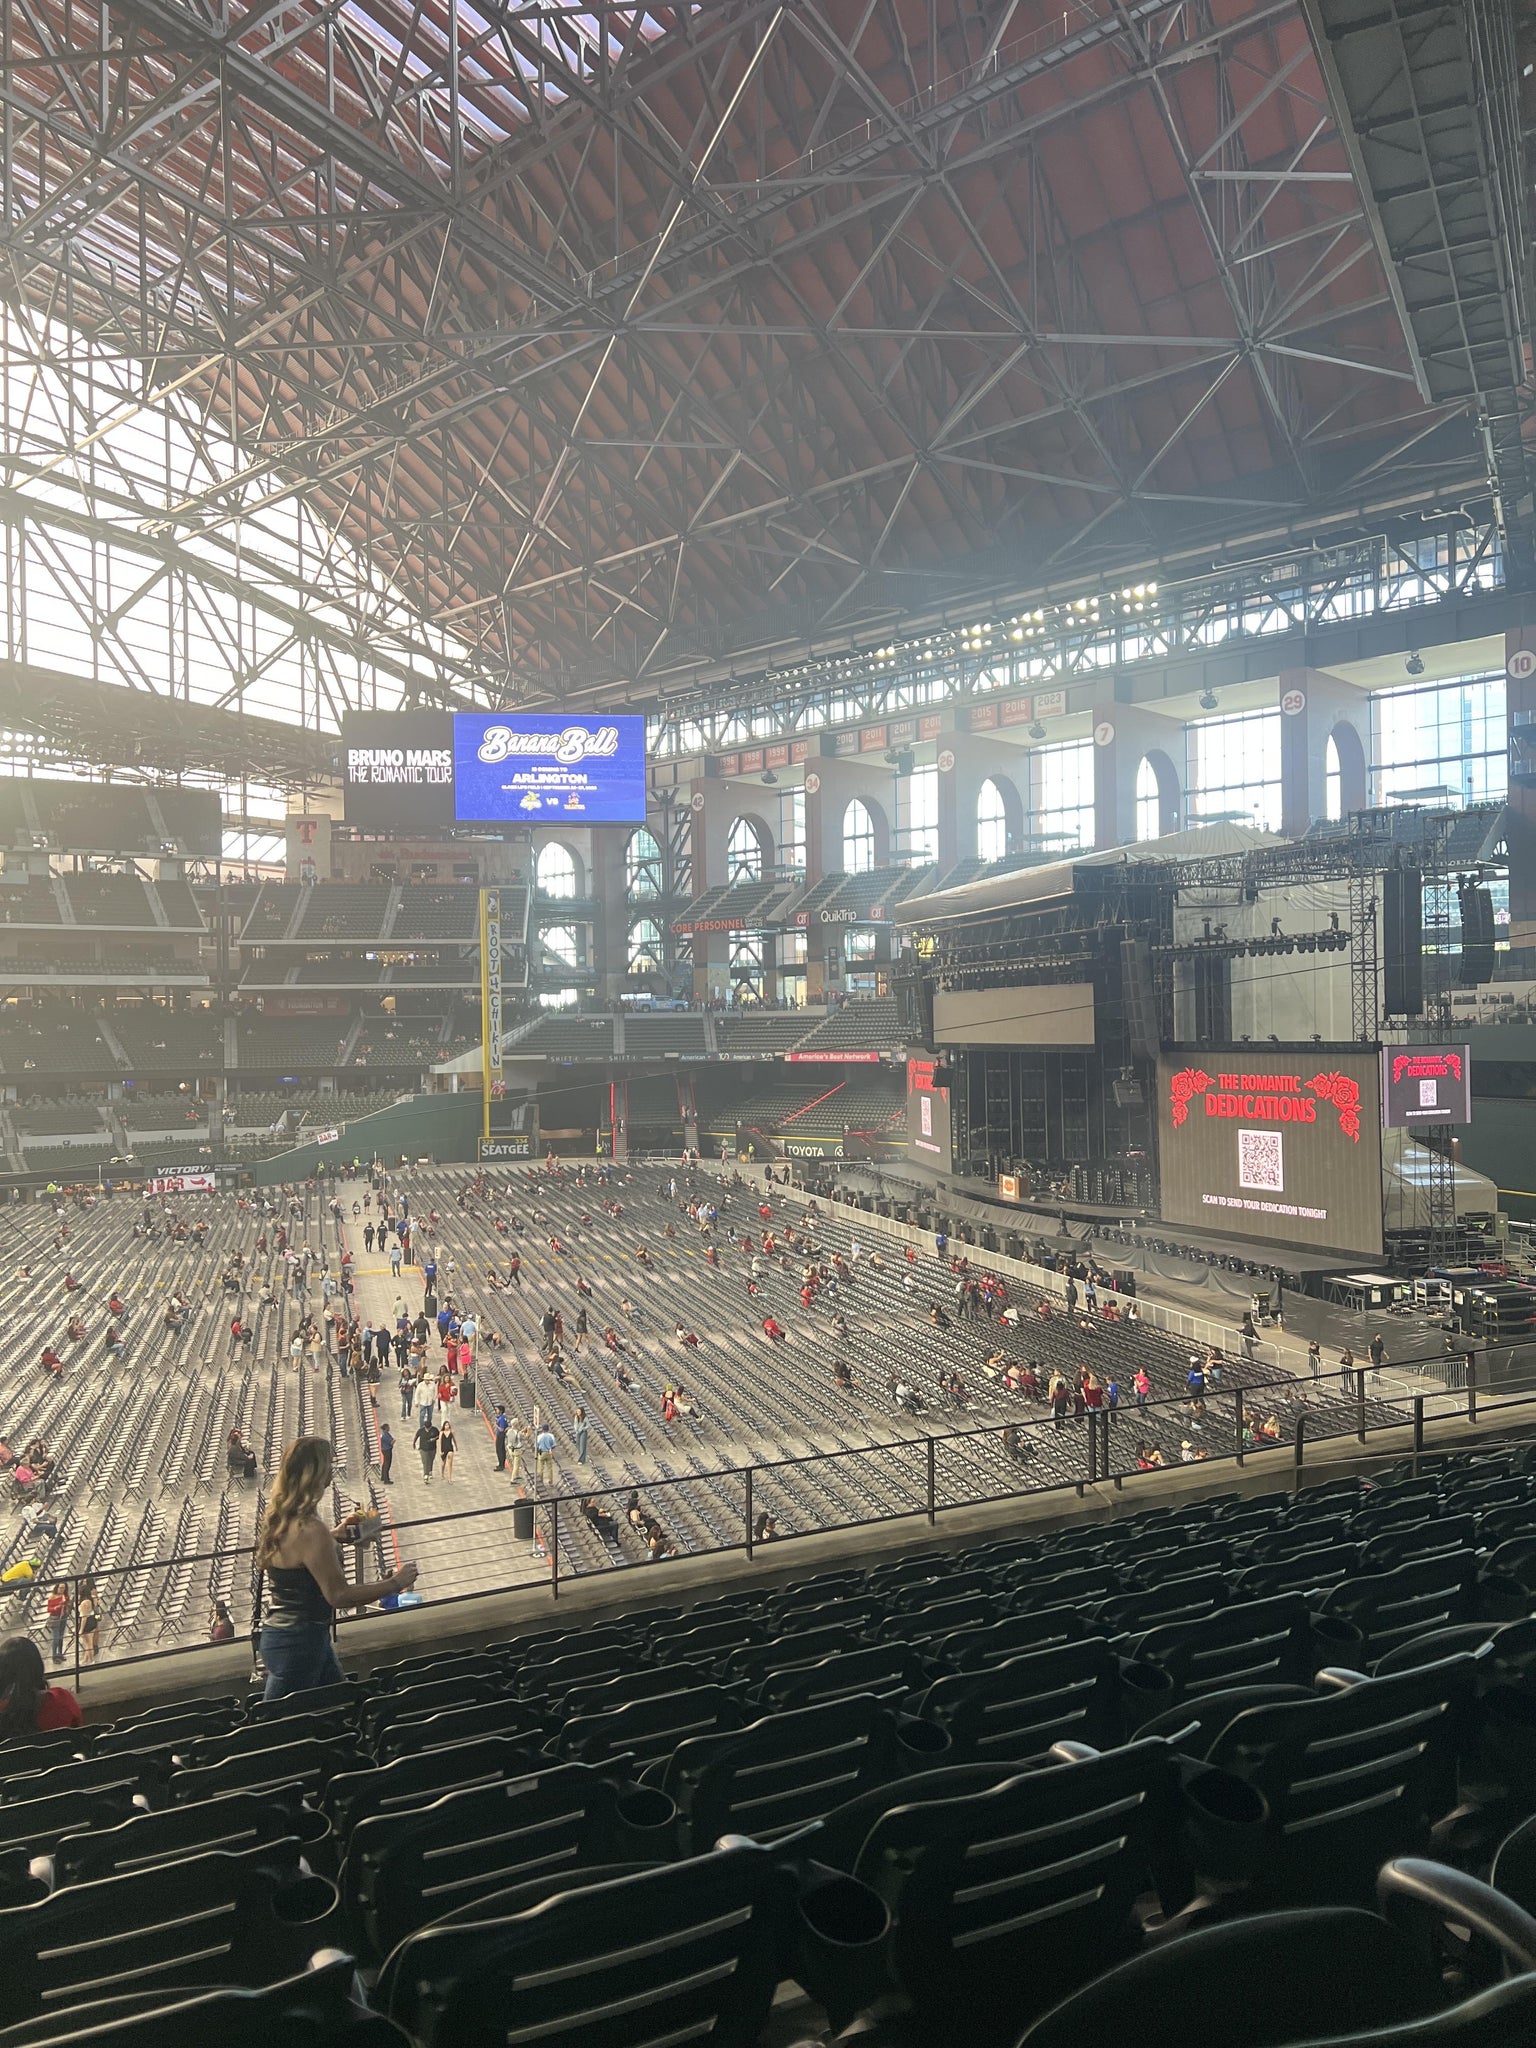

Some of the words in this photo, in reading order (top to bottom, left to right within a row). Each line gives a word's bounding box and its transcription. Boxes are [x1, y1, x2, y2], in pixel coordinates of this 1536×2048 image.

[1513, 656, 1532, 675] 10
[1037, 693, 1062, 706] 2023
[1284, 695, 1303, 711] 29
[971, 706, 992, 719] 2015
[1005, 701, 1026, 713] 2016
[865, 730, 882, 739] 2011
[894, 723, 911, 735] 2011
[1100, 727, 1109, 742] 7
[478, 726, 562, 763] Banana
[555, 727, 618, 764] Ball
[835, 734, 854, 745] 2010
[769, 746, 785, 757] 1999
[795, 742, 808, 753] 201
[348, 749, 403, 766] BRUNO
[406, 749, 452, 767] MARS
[940, 754, 953, 768] 26
[347, 766, 369, 783] THE
[371, 766, 423, 783] ROMANTIC
[424, 766, 452, 783] TOUR
[512, 773, 588, 784] ARLINGTON
[806, 778, 818, 790] 34
[545, 797, 559, 806] VS
[693, 795, 704, 809] 42
[296, 820, 318, 845] T
[820, 909, 857, 923] QuikTrip
[670, 922, 692, 933] CORE
[694, 918, 745, 931] PERSONNEL
[490, 924, 499, 970] ROOT
[490, 977, 499, 989] 4
[490, 996, 500, 1066] CHIKIN
[798, 1052, 829, 1060] America's
[1407, 1064, 1448, 1076] DEDICATIONS
[1217, 1073, 1239, 1090] THE
[1240, 1074, 1302, 1093] ROMANTIC
[1205, 1093, 1317, 1123] DEDICATIONS
[481, 1144, 529, 1156] SEATGEE
[787, 1145, 825, 1157] TOYOTA
[157, 1164, 208, 1175] VICTORY
[156, 1177, 185, 1192] BAR
[1202, 1194, 1218, 1205] SCAN
[1218, 1196, 1227, 1206] TO
[1227, 1197, 1243, 1208] SEND
[1243, 1199, 1260, 1210] YOUR
[1260, 1202, 1298, 1216] DEDICATION
[1298, 1206, 1328, 1219] TONIGHT
